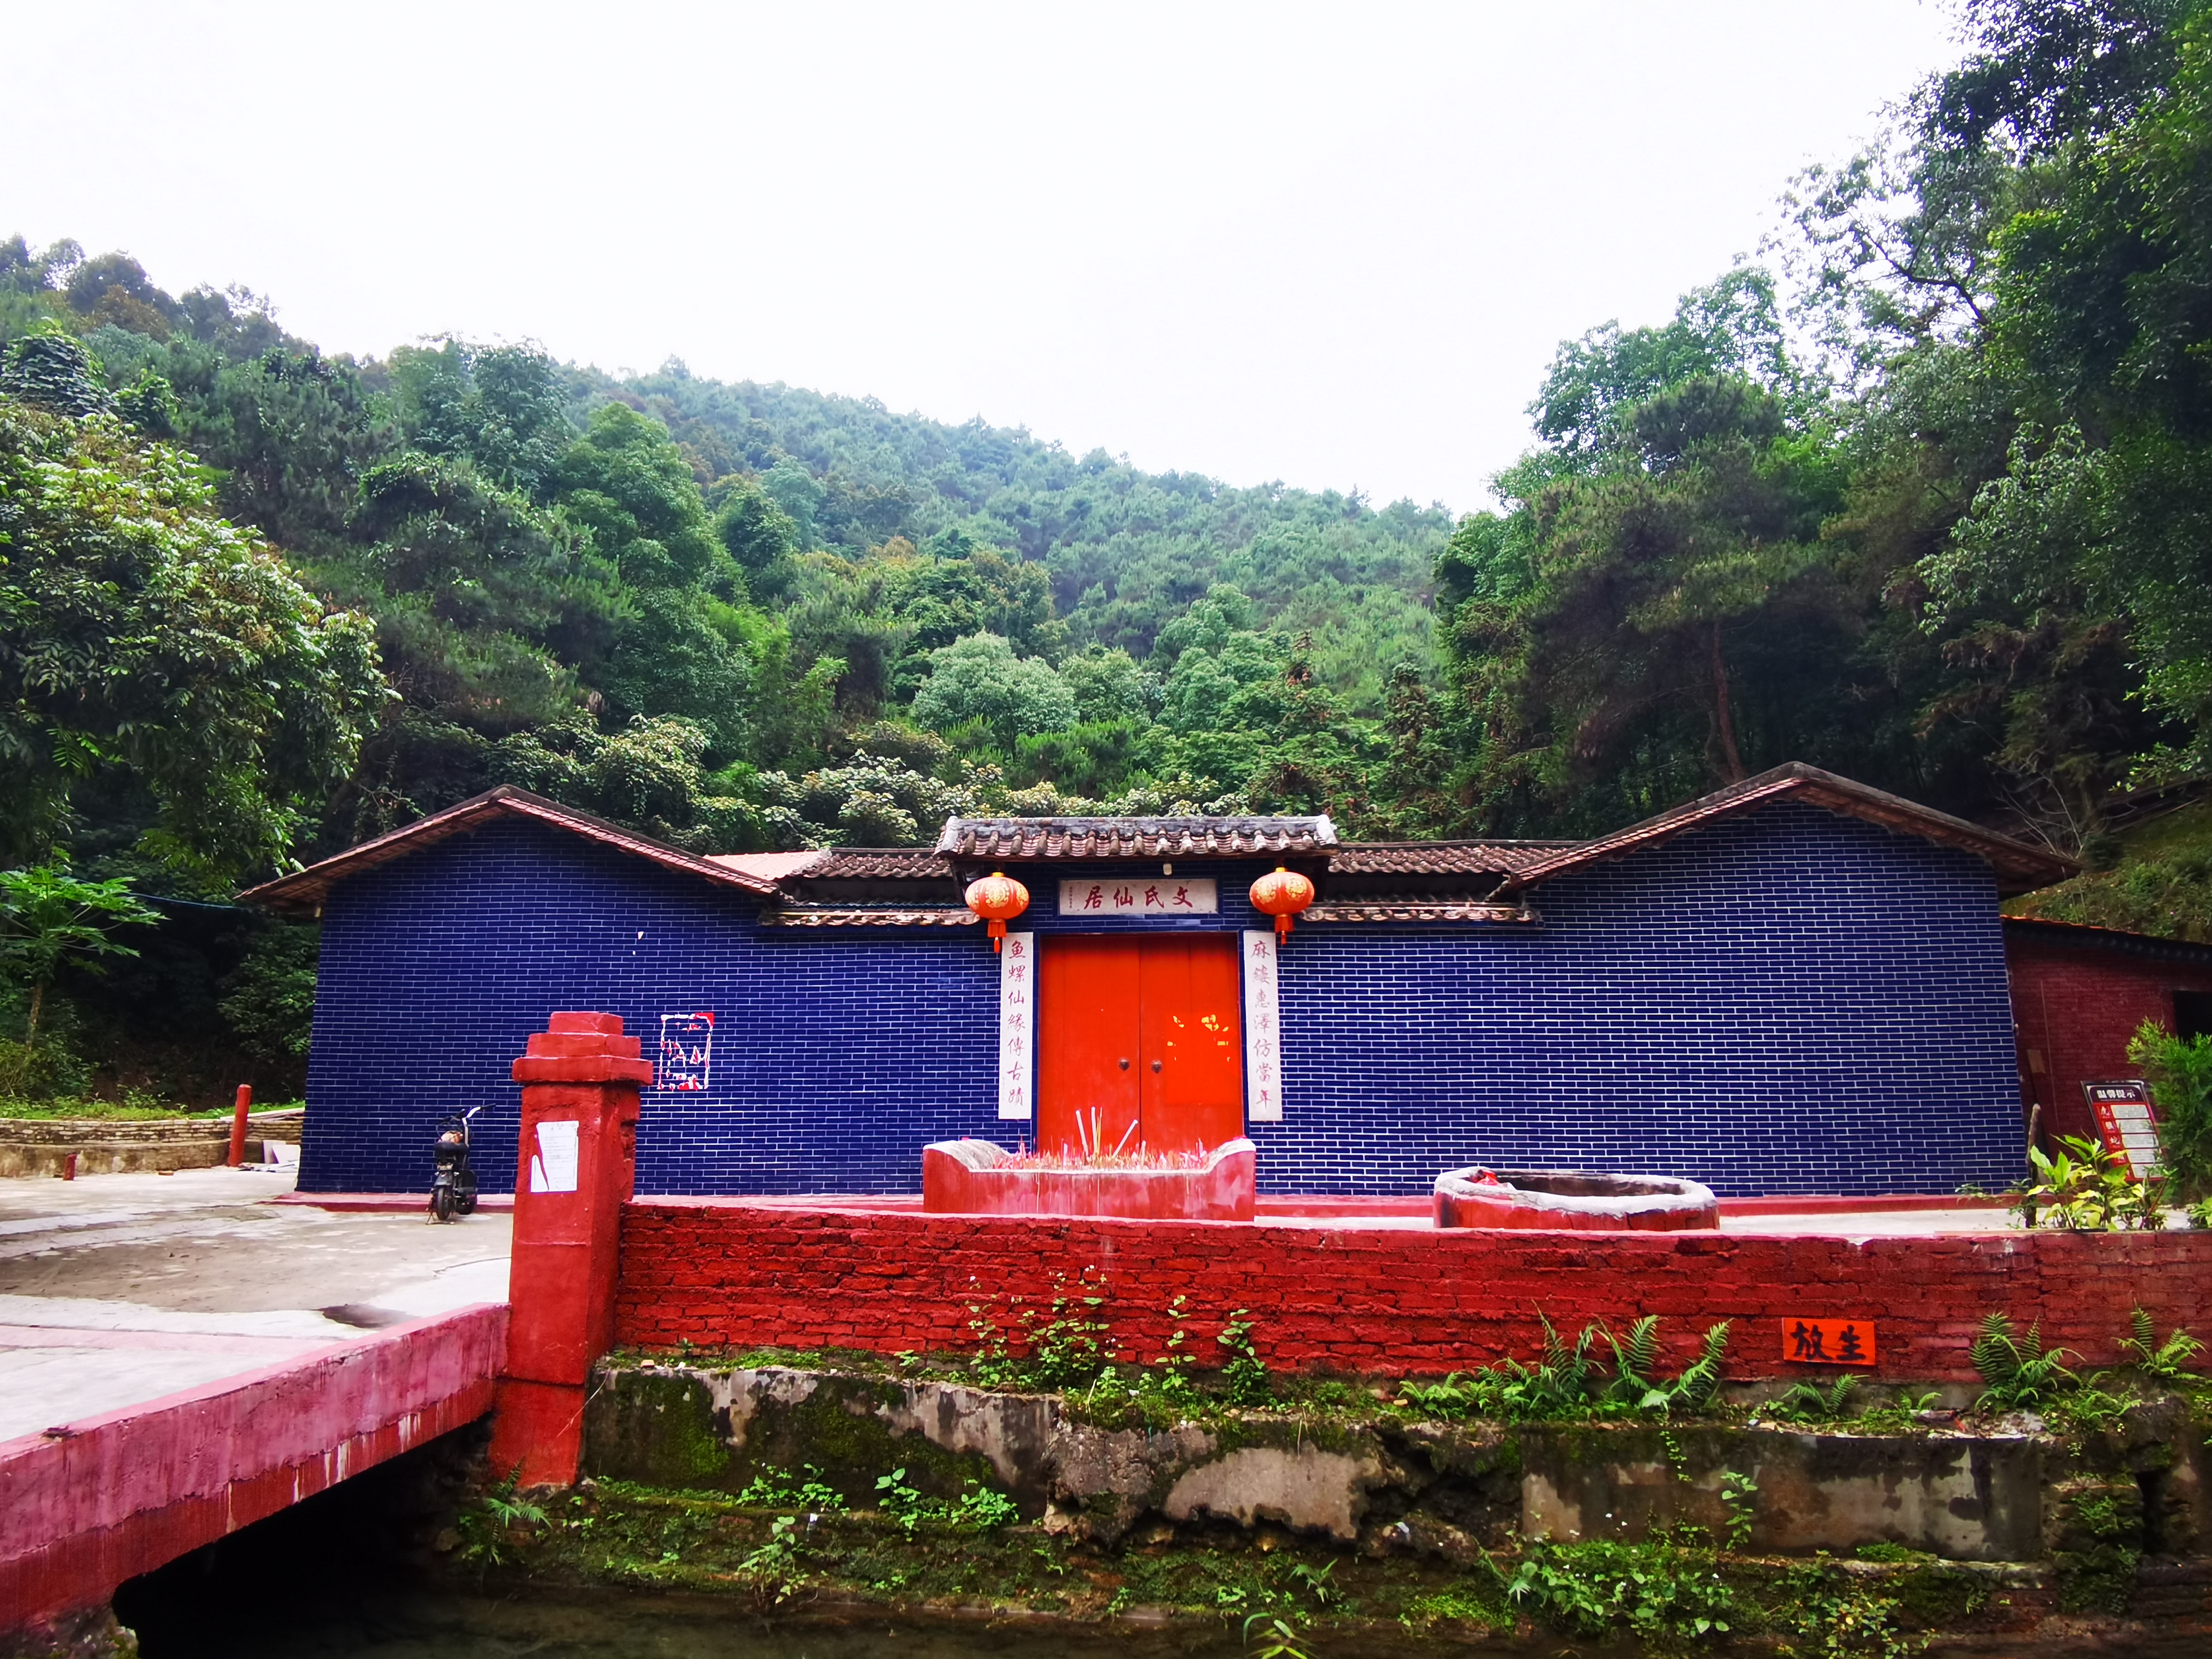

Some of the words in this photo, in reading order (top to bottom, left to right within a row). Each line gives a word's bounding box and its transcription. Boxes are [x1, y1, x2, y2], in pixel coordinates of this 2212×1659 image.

[1083, 885, 1193, 910] 文氏仙居
[1790, 1321, 1867, 1361] 放生
